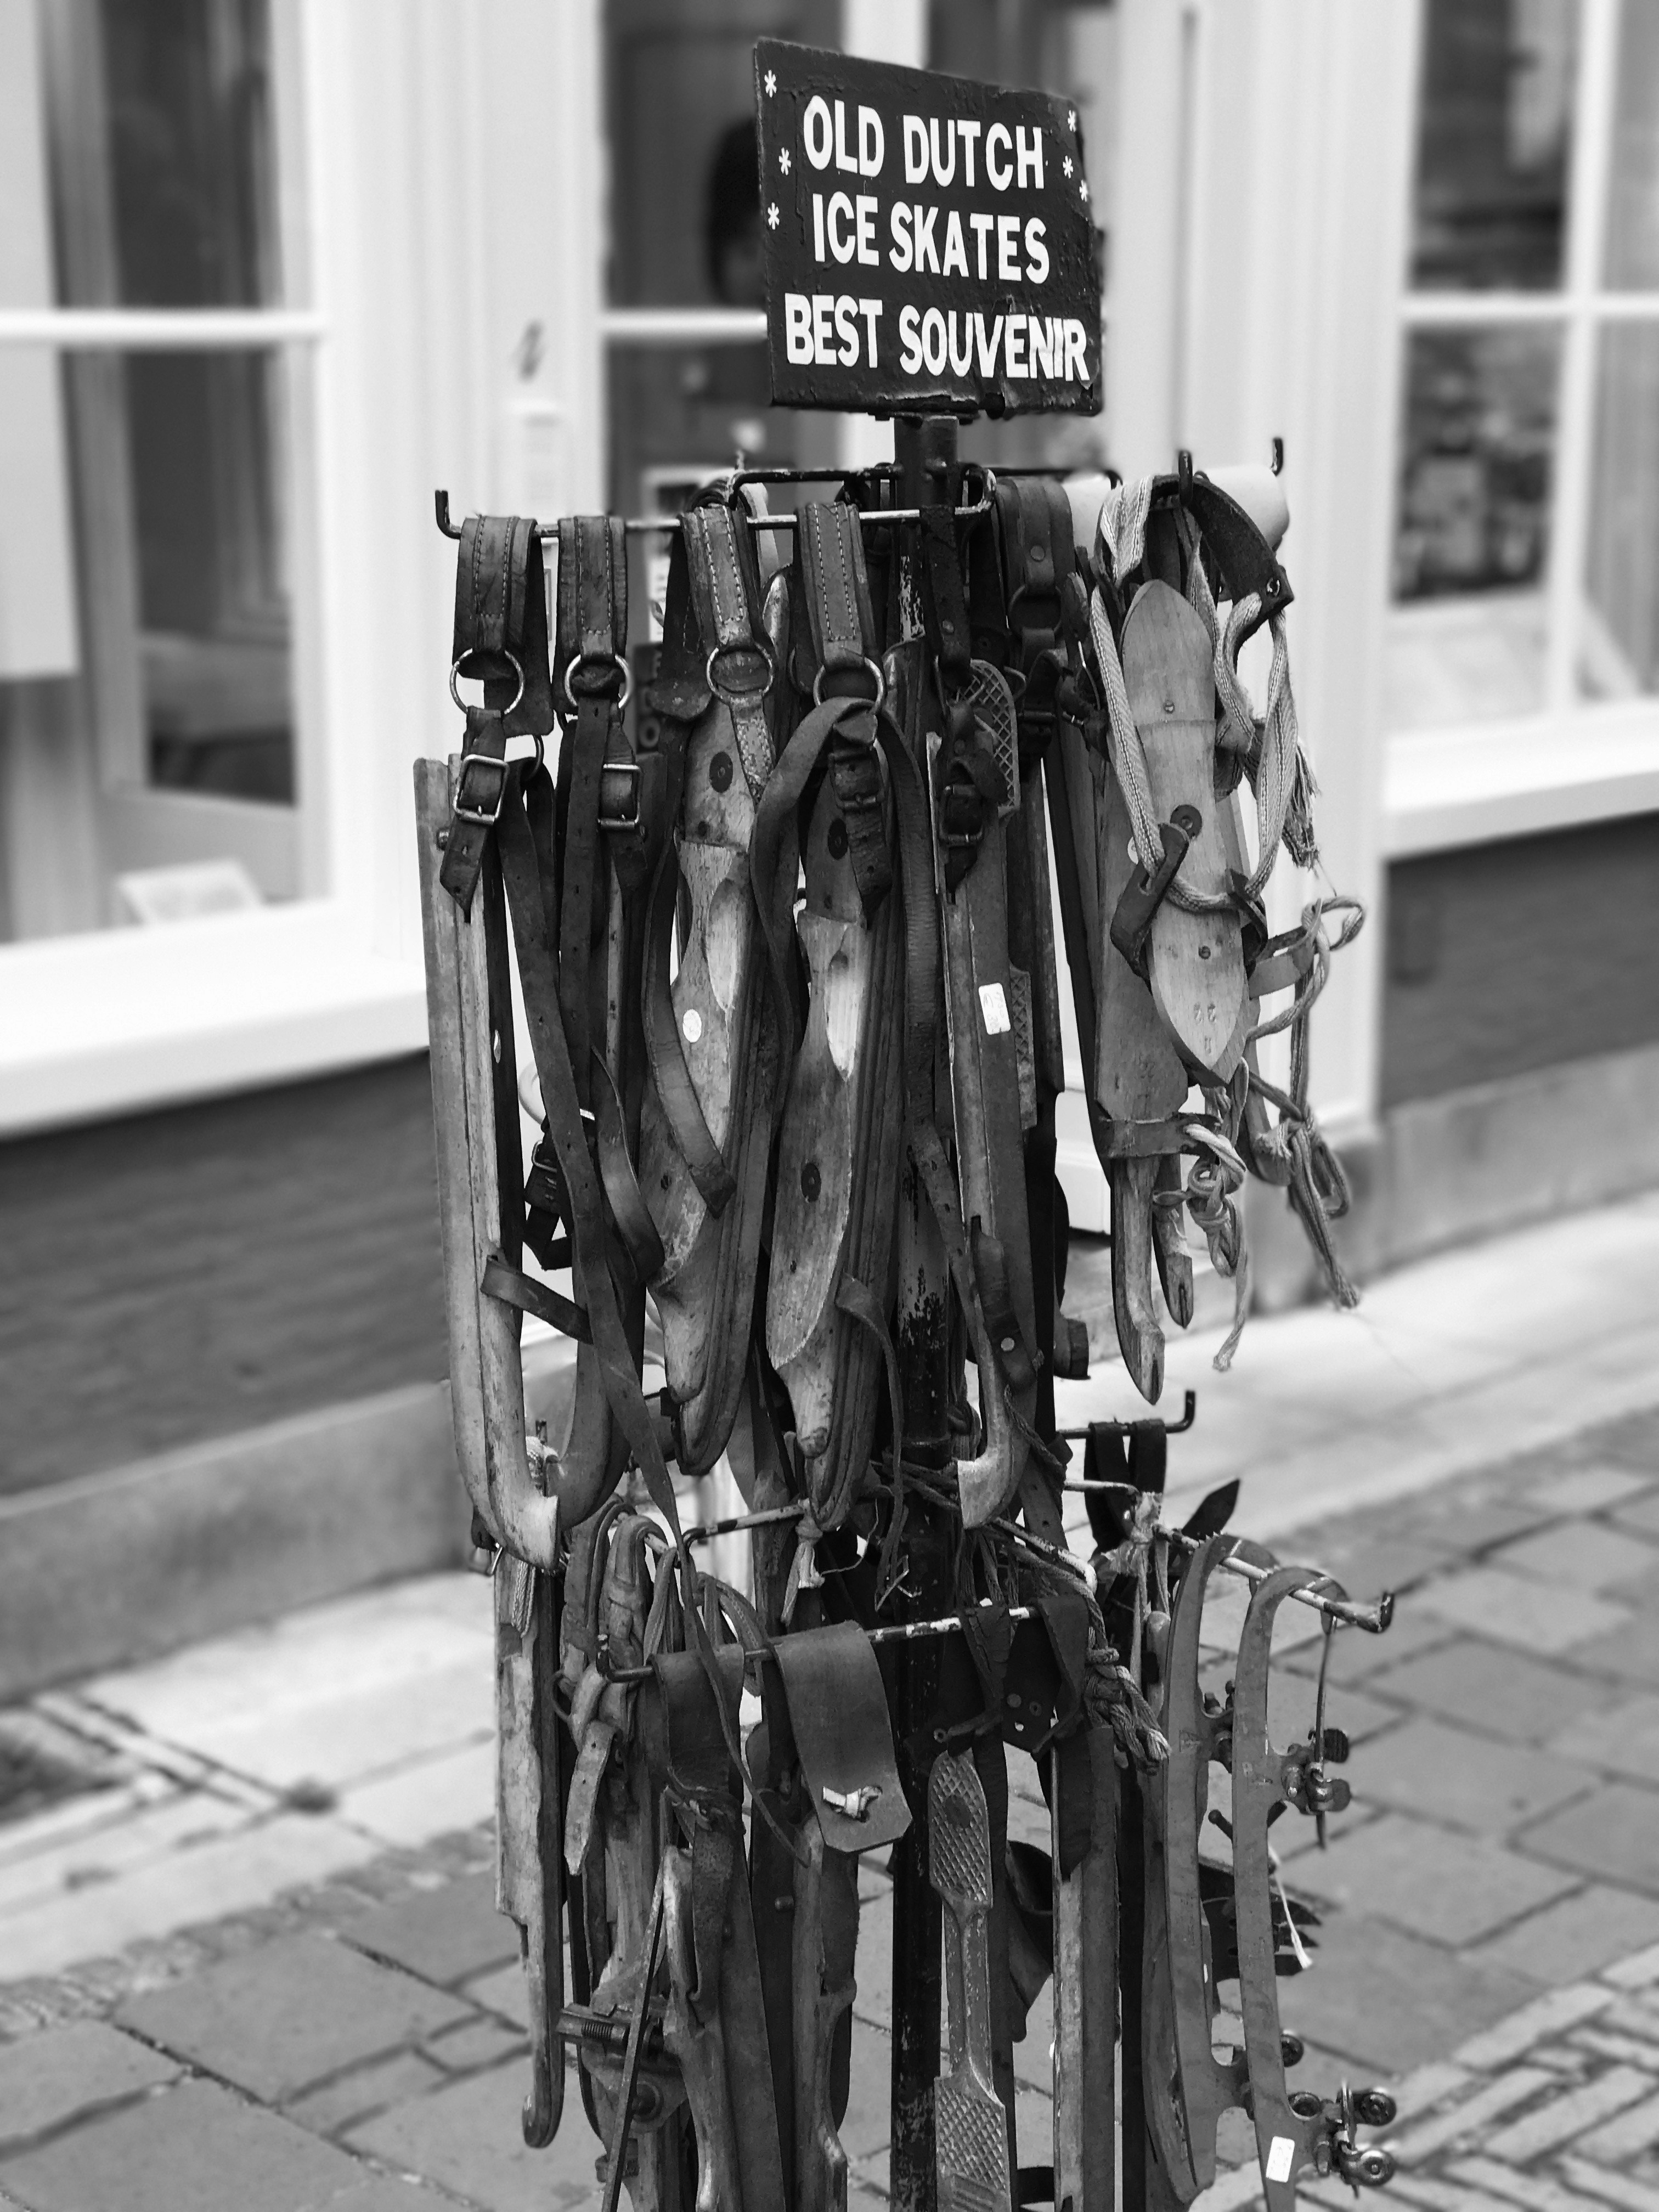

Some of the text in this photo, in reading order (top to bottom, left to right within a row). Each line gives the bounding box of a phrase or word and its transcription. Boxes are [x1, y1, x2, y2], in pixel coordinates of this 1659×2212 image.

[803, 95, 1045, 191] OLD DUTCH
[812, 191, 1049, 284] ICE SKATES
[785, 292, 1090, 382] BEST SOUVENIR
